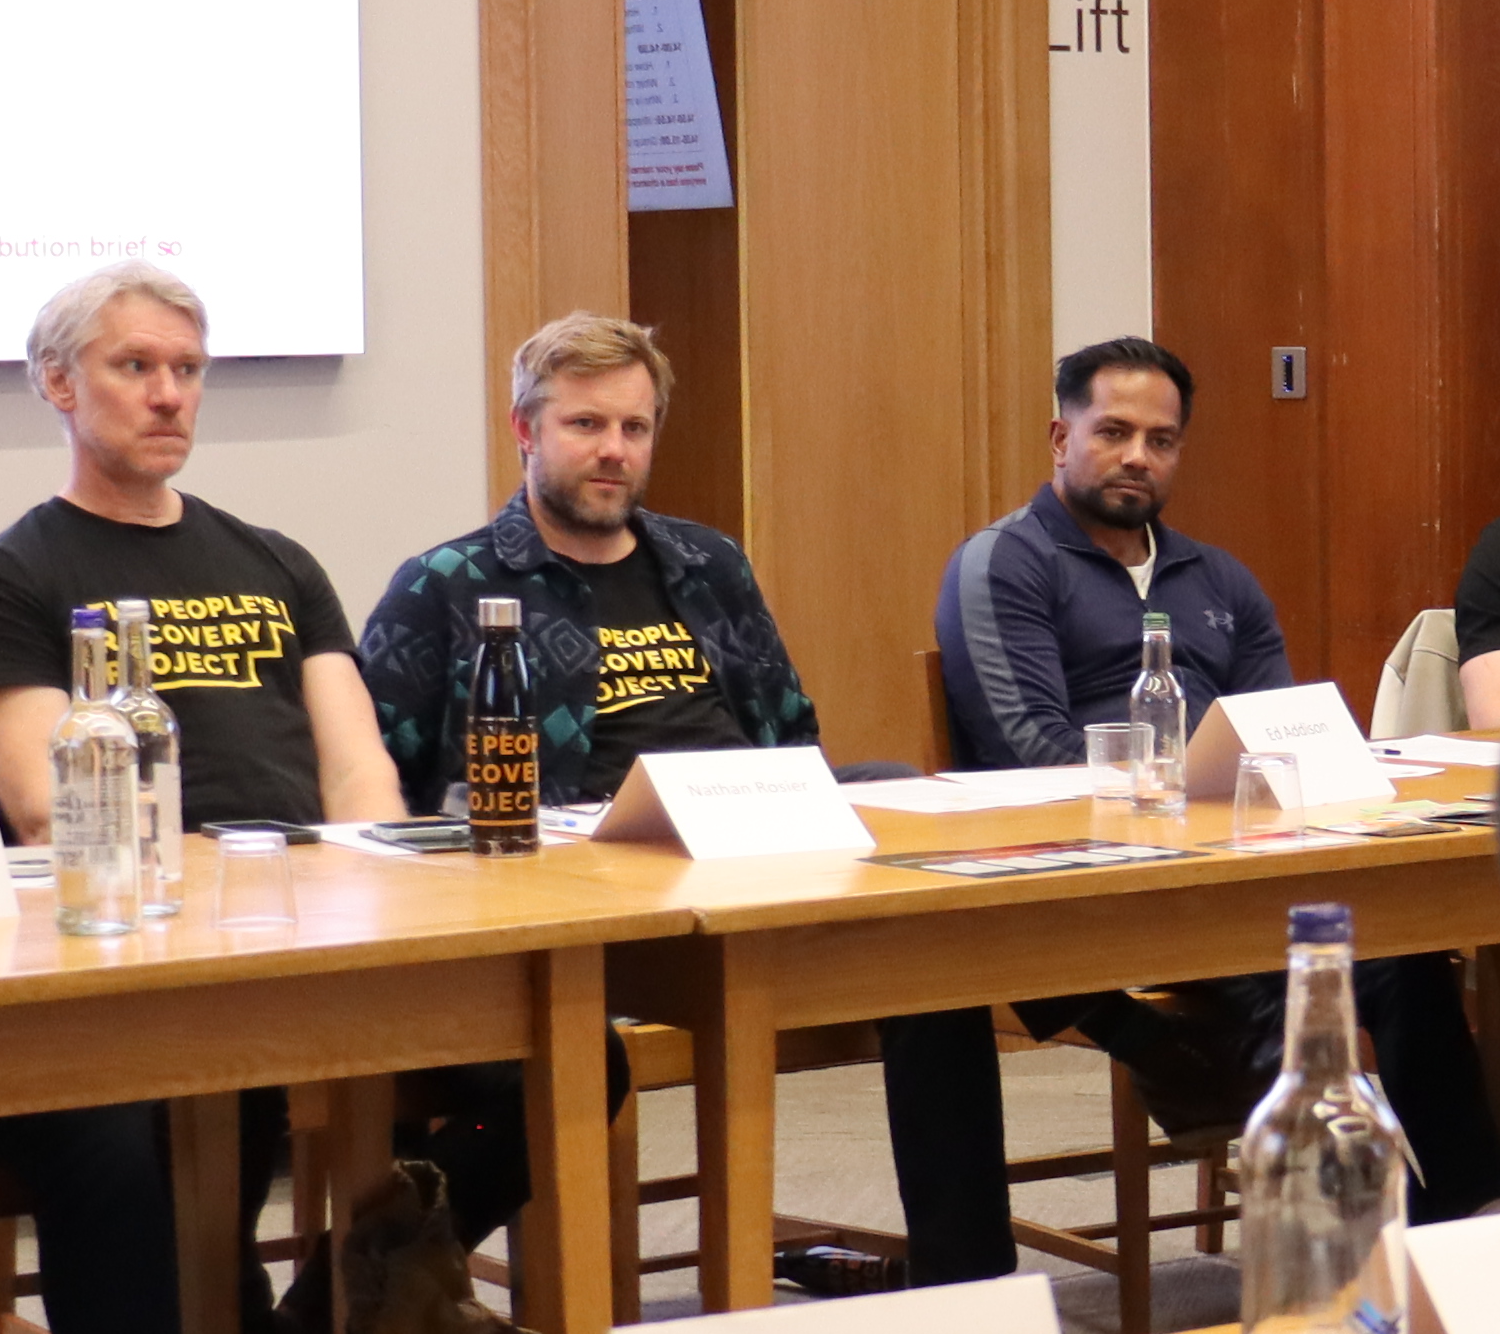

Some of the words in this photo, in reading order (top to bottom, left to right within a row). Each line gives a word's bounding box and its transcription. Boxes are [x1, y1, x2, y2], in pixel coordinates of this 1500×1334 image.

[90, 235, 147, 259] brief
[157, 240, 183, 257] so
[151, 595, 280, 621] PEOPLE'S
[104, 620, 261, 651] RCOVERY
[1283, 722, 1330, 739] Addison
[482, 733, 539, 757] PEO
[466, 761, 539, 784] COVE
[686, 782, 752, 797] Nathan
[755, 779, 808, 795] Rosier
